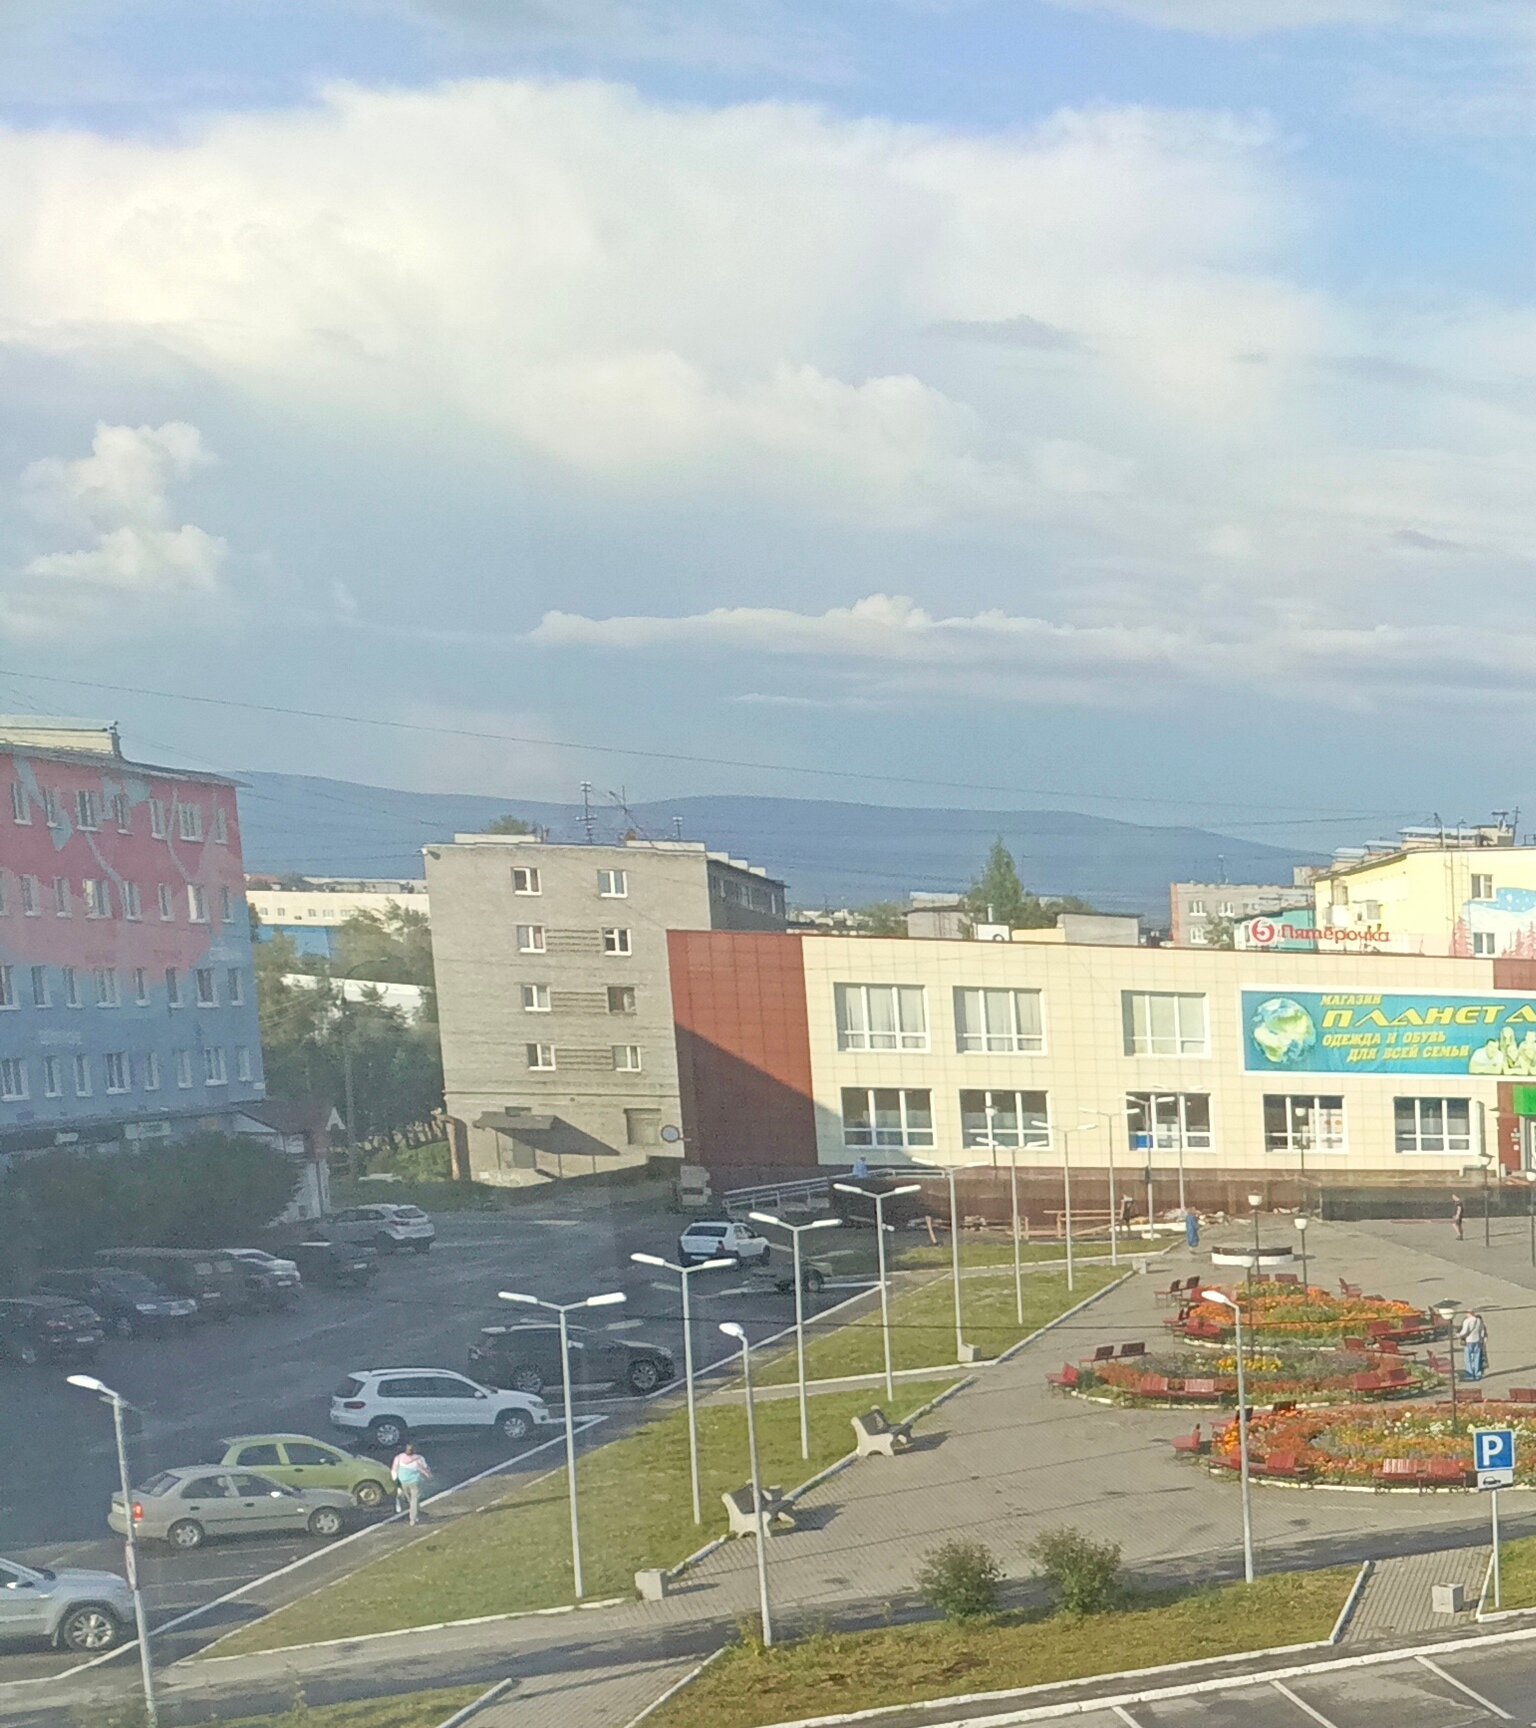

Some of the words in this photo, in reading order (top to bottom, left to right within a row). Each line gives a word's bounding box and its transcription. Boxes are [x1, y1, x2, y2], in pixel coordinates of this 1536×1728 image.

[1281, 924, 1390, 944] Пятёрочка
[1321, 994, 1383, 1006] МАГАЗИН
[1322, 1032, 1382, 1047] ОДЕЖДА
[1386, 1032, 1397, 1044] И
[1402, 1031, 1447, 1044] ОБУВЬ
[1346, 1047, 1379, 1062] ДЛЯ
[1383, 1044, 1420, 1059] ВСЕЙ
[1422, 1045, 1470, 1059] СЕМЬИ
[1482, 1434, 1504, 1466] P
